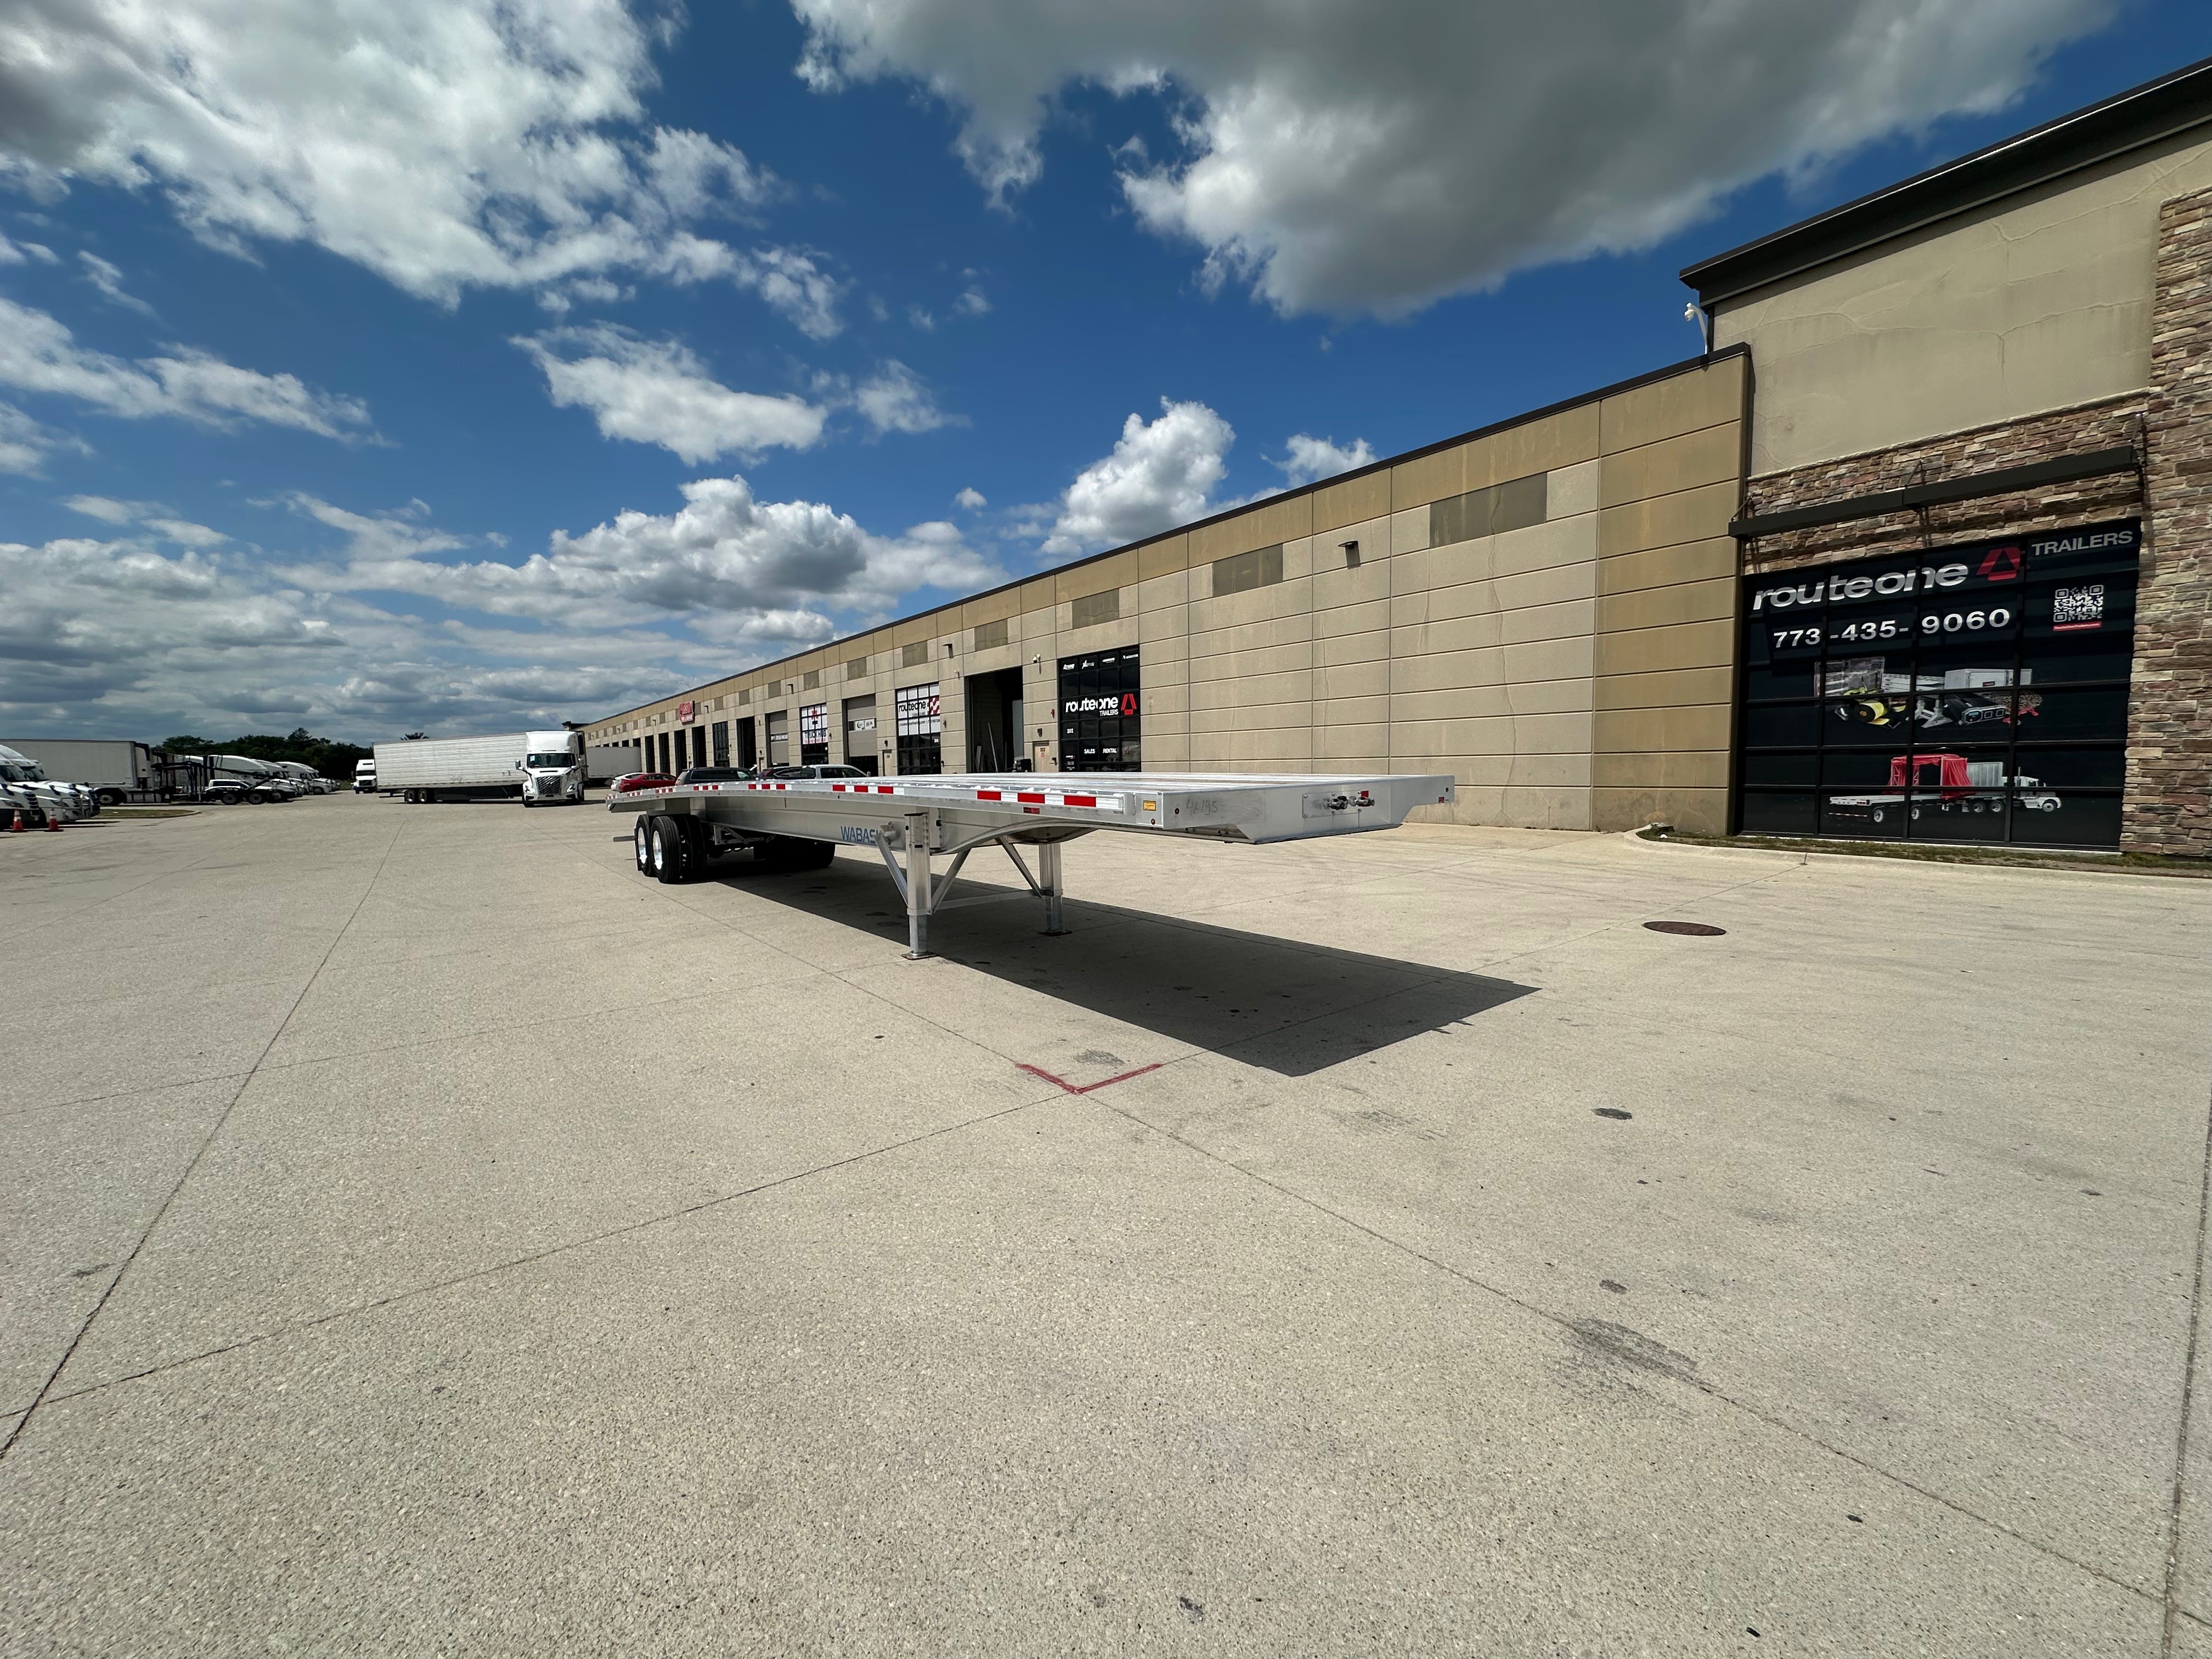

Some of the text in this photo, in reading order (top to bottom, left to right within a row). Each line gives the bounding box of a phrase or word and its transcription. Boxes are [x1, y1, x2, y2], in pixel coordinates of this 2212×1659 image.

[2031, 531, 2133, 556] TRAILERS
[1752, 563, 1969, 611] routeone
[899, 701, 926, 713] routeone
[1065, 697, 1119, 713] routeone
[840, 825, 878, 844] WABAS
